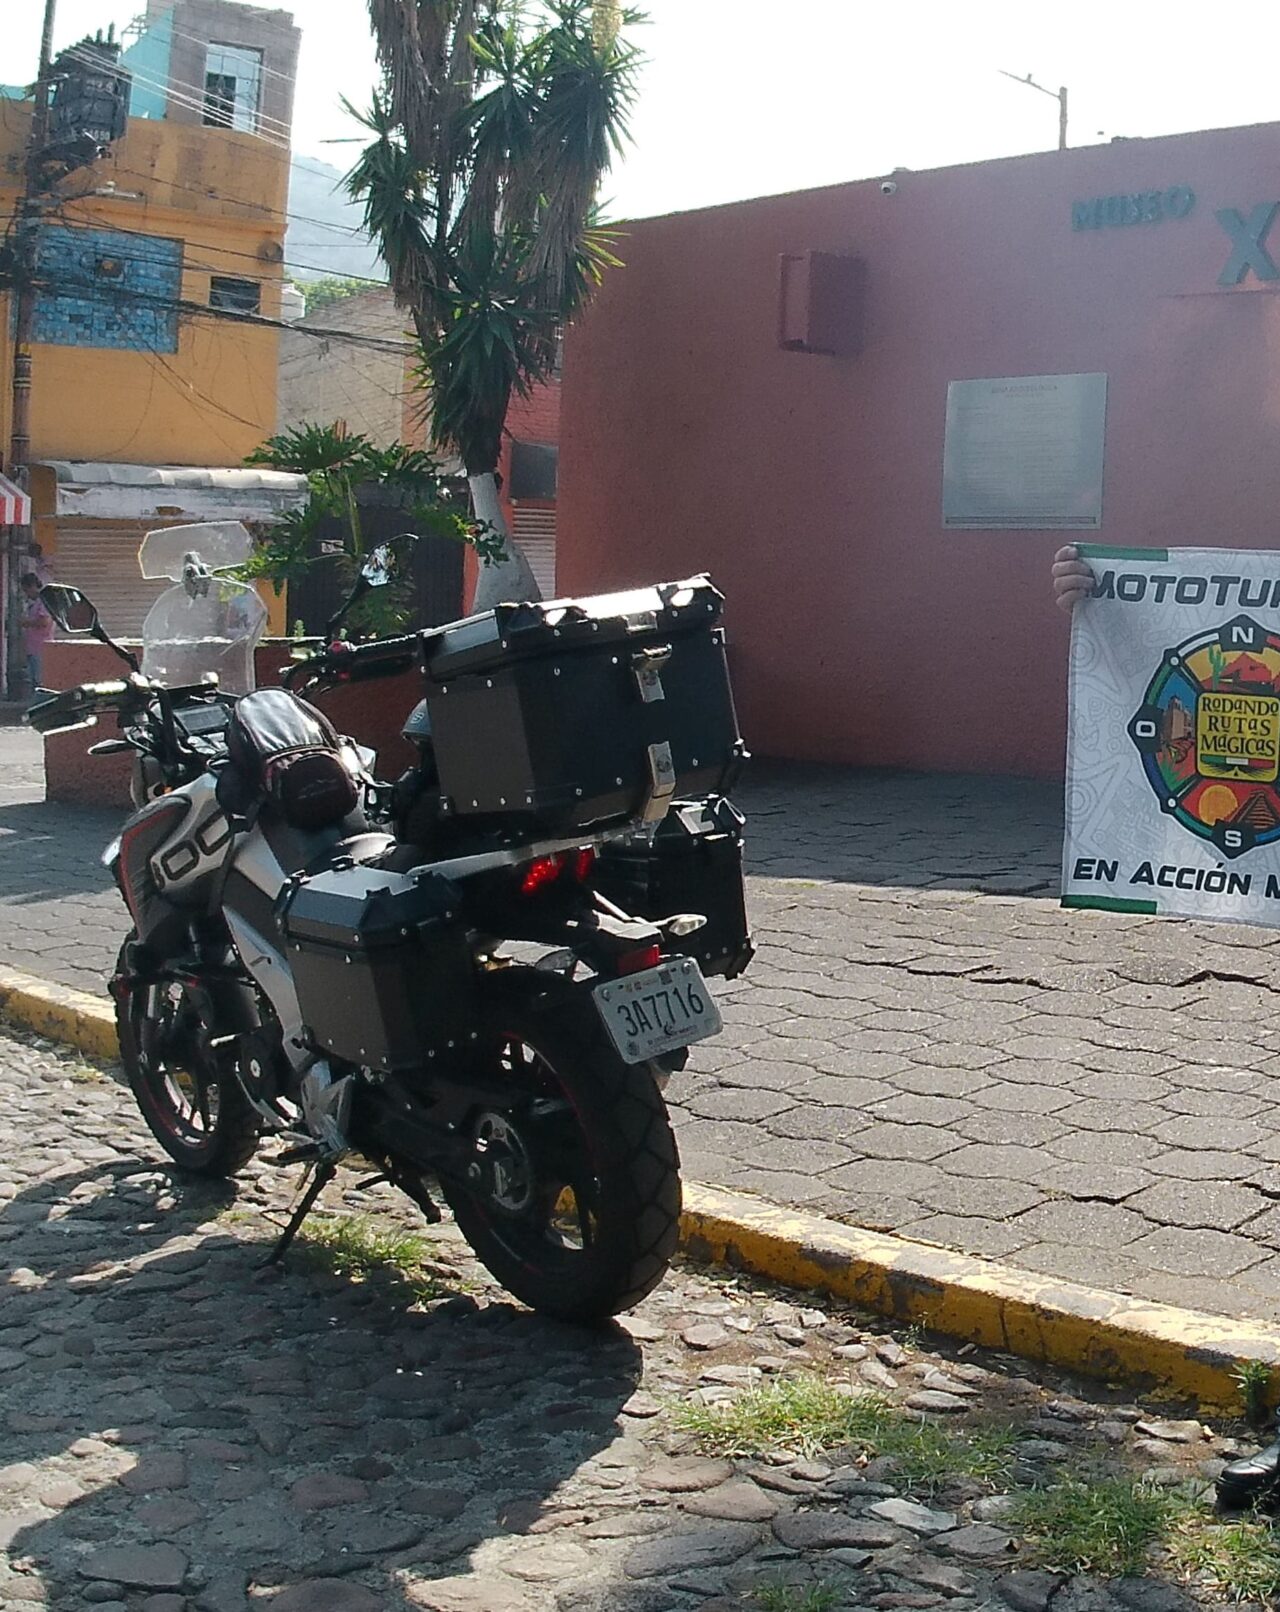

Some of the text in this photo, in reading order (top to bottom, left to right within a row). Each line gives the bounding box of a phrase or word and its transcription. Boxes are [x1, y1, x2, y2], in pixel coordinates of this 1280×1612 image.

[1231, 626, 1254, 643] N
[1224, 829, 1242, 847] S
[1073, 858, 1119, 882] EN
[1129, 862, 1252, 896] ACCIÓN
[617, 983, 704, 1036] 3A7716
